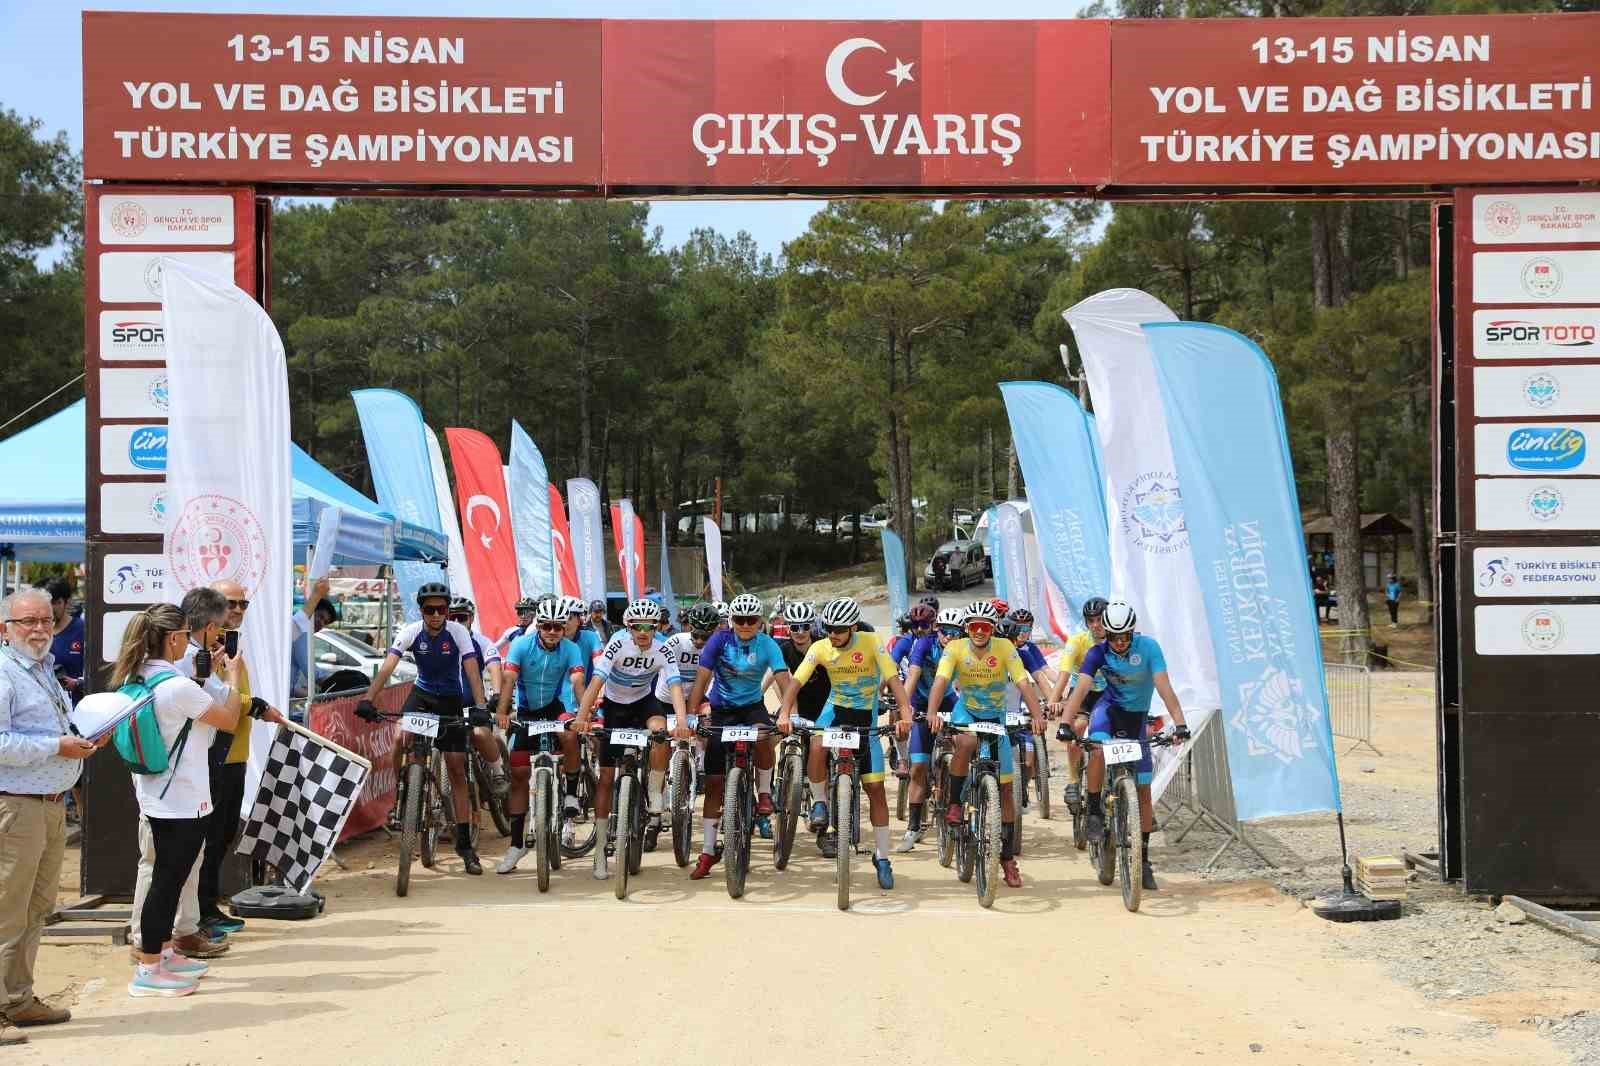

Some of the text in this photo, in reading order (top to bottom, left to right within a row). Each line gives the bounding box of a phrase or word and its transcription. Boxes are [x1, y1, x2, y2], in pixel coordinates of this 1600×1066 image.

[227, 30, 464, 64] 13-15 NİSAN
[1252, 30, 1490, 64] 13-15 NİSAN
[123, 79, 565, 115] YOL VE DAĞ BİSİKLETİ
[1150, 76, 1592, 114] YOL VE DAĞ BİSİKLETİ
[114, 126, 573, 168] TÜRKİYE ŞAMPİYONASI
[692, 113, 1021, 168] ÇIKIŞ-VARIŞ
[1140, 127, 1600, 168] TÜRKİYE ŞAMPİYONASI
[112, 328, 165, 343] SPOR
[1515, 559, 1558, 570] TÜRKİYE
[1522, 574, 1596, 582] FEDERASYONU
[604, 639, 624, 660] DEU
[658, 645, 676, 664] DEU
[680, 651, 700, 664] DE
[622, 656, 655, 670] DEU
[619, 732, 640, 741] 021
[729, 730, 750, 738] 014
[831, 732, 853, 741] 046
[1112, 744, 1134, 755] 012
